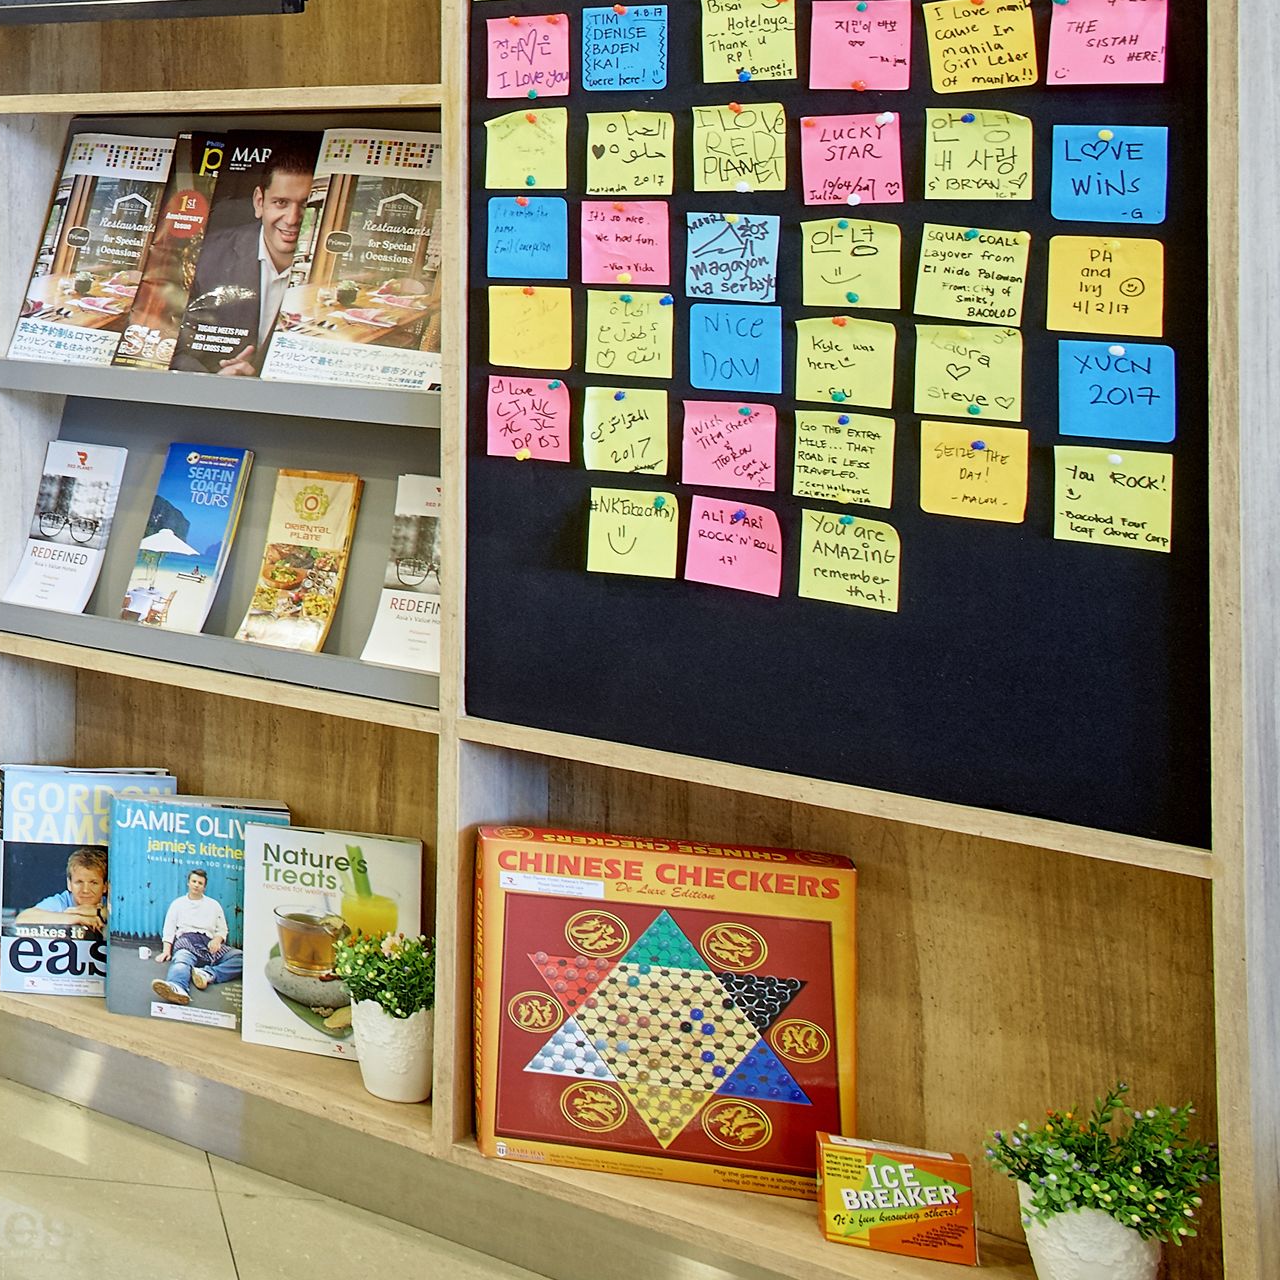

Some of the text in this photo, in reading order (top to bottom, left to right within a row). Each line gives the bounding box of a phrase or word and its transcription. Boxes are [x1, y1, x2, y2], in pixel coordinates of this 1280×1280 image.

[591, 13, 620, 25] TIM
[1067, 21, 1097, 33] THE
[593, 27, 646, 40] DENISE
[1086, 36, 1138, 47] SISTAH
[592, 42, 640, 54] BADEN
[709, 41, 748, 52] Thank
[706, 132, 776, 167] RED
[825, 146, 882, 161] STAR
[363, 220, 432, 237] Restaurants
[368, 239, 415, 252] for Special
[365, 251, 414, 264] Occasions
[924, 248, 1014, 262] Layover from
[1081, 267, 1111, 278] and
[704, 315, 764, 338] Nice
[702, 350, 760, 382] Day
[1089, 385, 1161, 405] 2017
[847, 427, 881, 440] EXTRA
[611, 438, 651, 463] 2017
[847, 443, 875, 454] THAT
[985, 450, 1009, 464] THE
[798, 451, 870, 469] ROAD LESS
[188, 466, 235, 483] SEAT-IN
[190, 480, 231, 495] COACH
[191, 491, 229, 508] TOURS
[854, 526, 886, 542] are
[30, 545, 89, 567] REDEFINED
[814, 566, 890, 585] remember
[116, 808, 189, 835] JAMIE
[147, 837, 195, 854] jamie's
[543, 834, 788, 862] CHINESE CHECKERS
[262, 842, 368, 875] Nature's
[262, 864, 337, 890] Treats
[497, 850, 841, 900] CHINESE CHECKERS
[616, 881, 716, 901] De Luxe Edition
[16, 926, 84, 939] makes it
[866, 1164, 920, 1188] ICE
[841, 1185, 958, 1210] BREAKER
[833, 1206, 959, 1227] It's fun knowing others!
